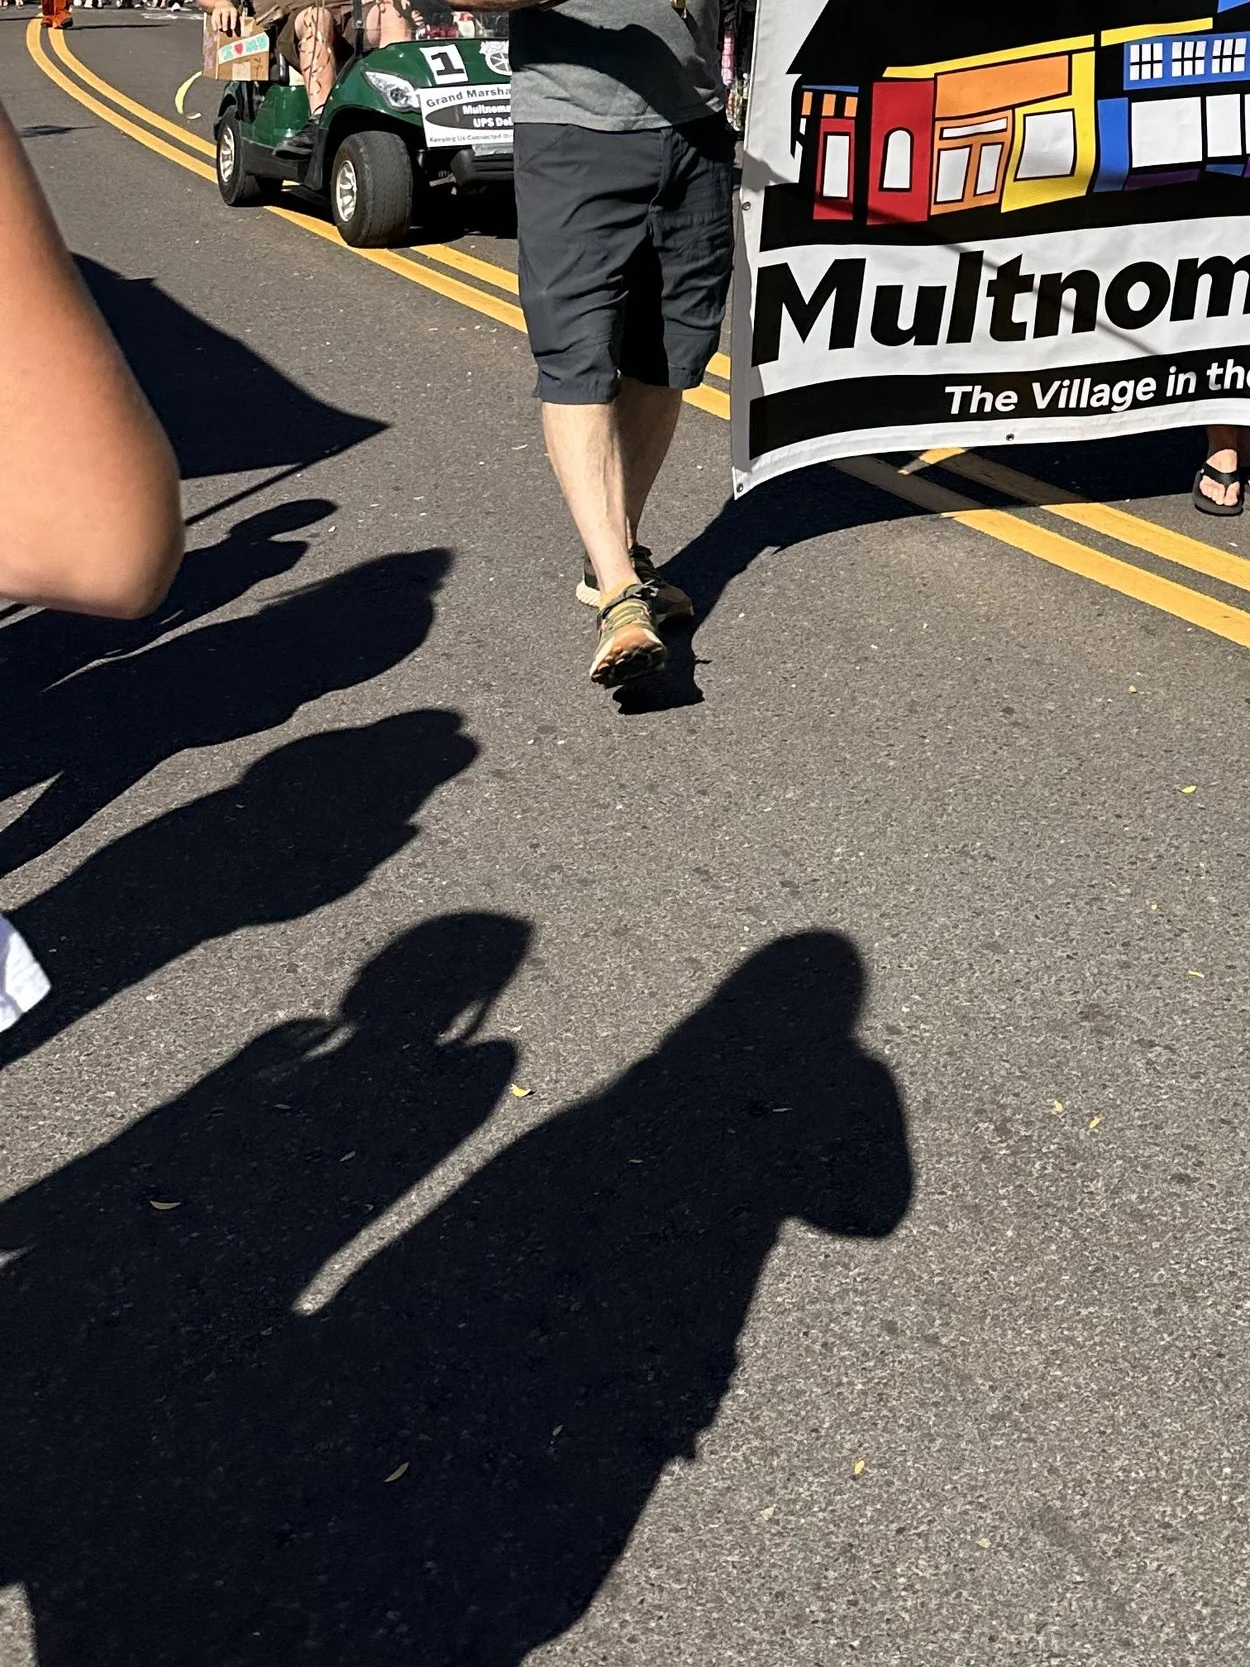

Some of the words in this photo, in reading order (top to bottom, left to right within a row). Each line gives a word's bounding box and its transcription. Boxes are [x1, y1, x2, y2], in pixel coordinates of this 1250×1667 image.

[430, 52, 465, 76] 1
[426, 91, 463, 107] Grand
[466, 87, 510, 99] Marsha
[462, 105, 511, 115] Multnoma
[473, 118, 495, 127] UPS
[495, 117, 513, 126] Del
[945, 385, 1018, 415] The
[1032, 376, 1157, 413] Village
[1166, 367, 1196, 394] in
